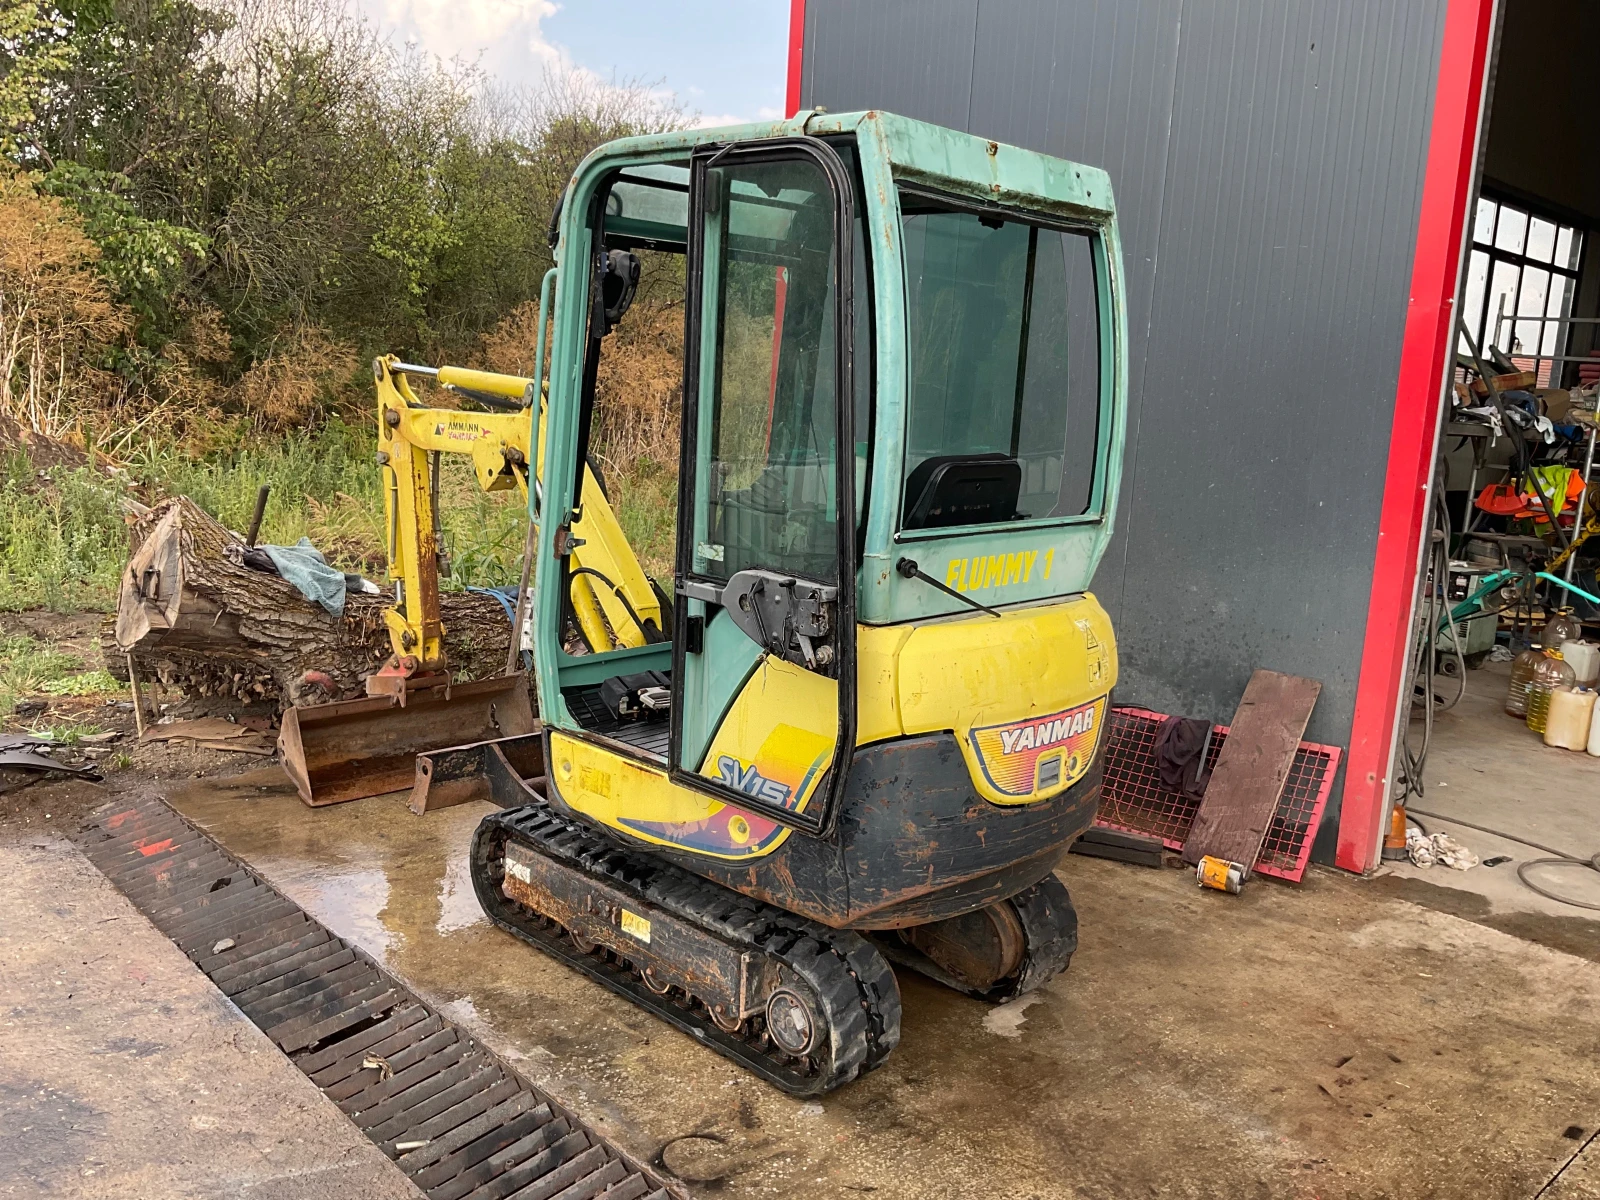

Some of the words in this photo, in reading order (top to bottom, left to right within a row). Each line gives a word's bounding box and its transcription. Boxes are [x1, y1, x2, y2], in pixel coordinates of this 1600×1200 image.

[448, 421, 479, 432] AMMANN
[944, 550, 1038, 595] FLUMMY
[1043, 548, 1055, 580] 1
[1000, 706, 1095, 755] YANMAR
[712, 755, 792, 806] SV15
